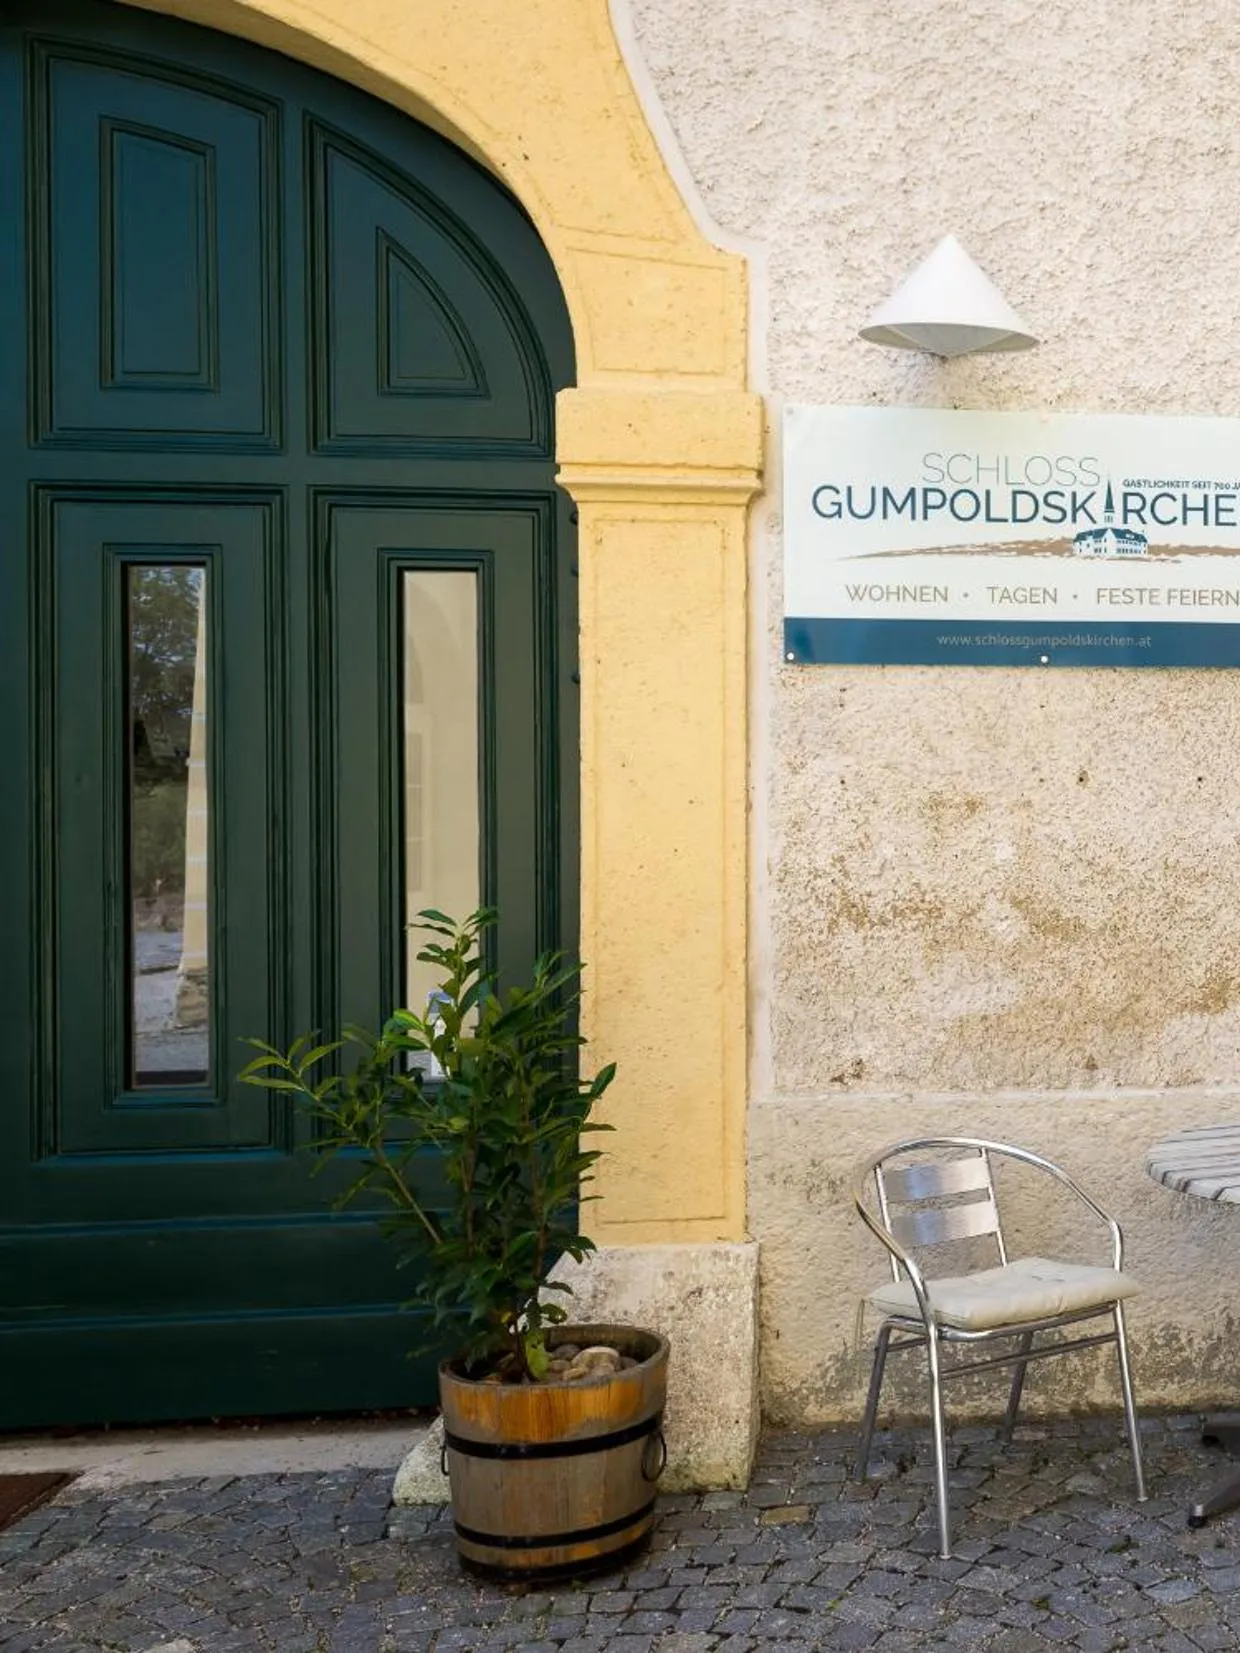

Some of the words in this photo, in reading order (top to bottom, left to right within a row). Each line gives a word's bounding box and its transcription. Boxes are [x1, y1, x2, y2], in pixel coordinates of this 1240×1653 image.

[921, 451, 1100, 487] SCHLOSS
[1122, 478, 1190, 489] GASTLICHKEIT
[1192, 480, 1211, 490] SEIT
[846, 583, 949, 603] WOHNEN
[986, 586, 1058, 605] TAGEN
[1096, 588, 1160, 605] FESTE
[1167, 589, 1240, 607] FEIERN
[936, 633, 1152, 649] www.schlossgumpoldskirchen.at
